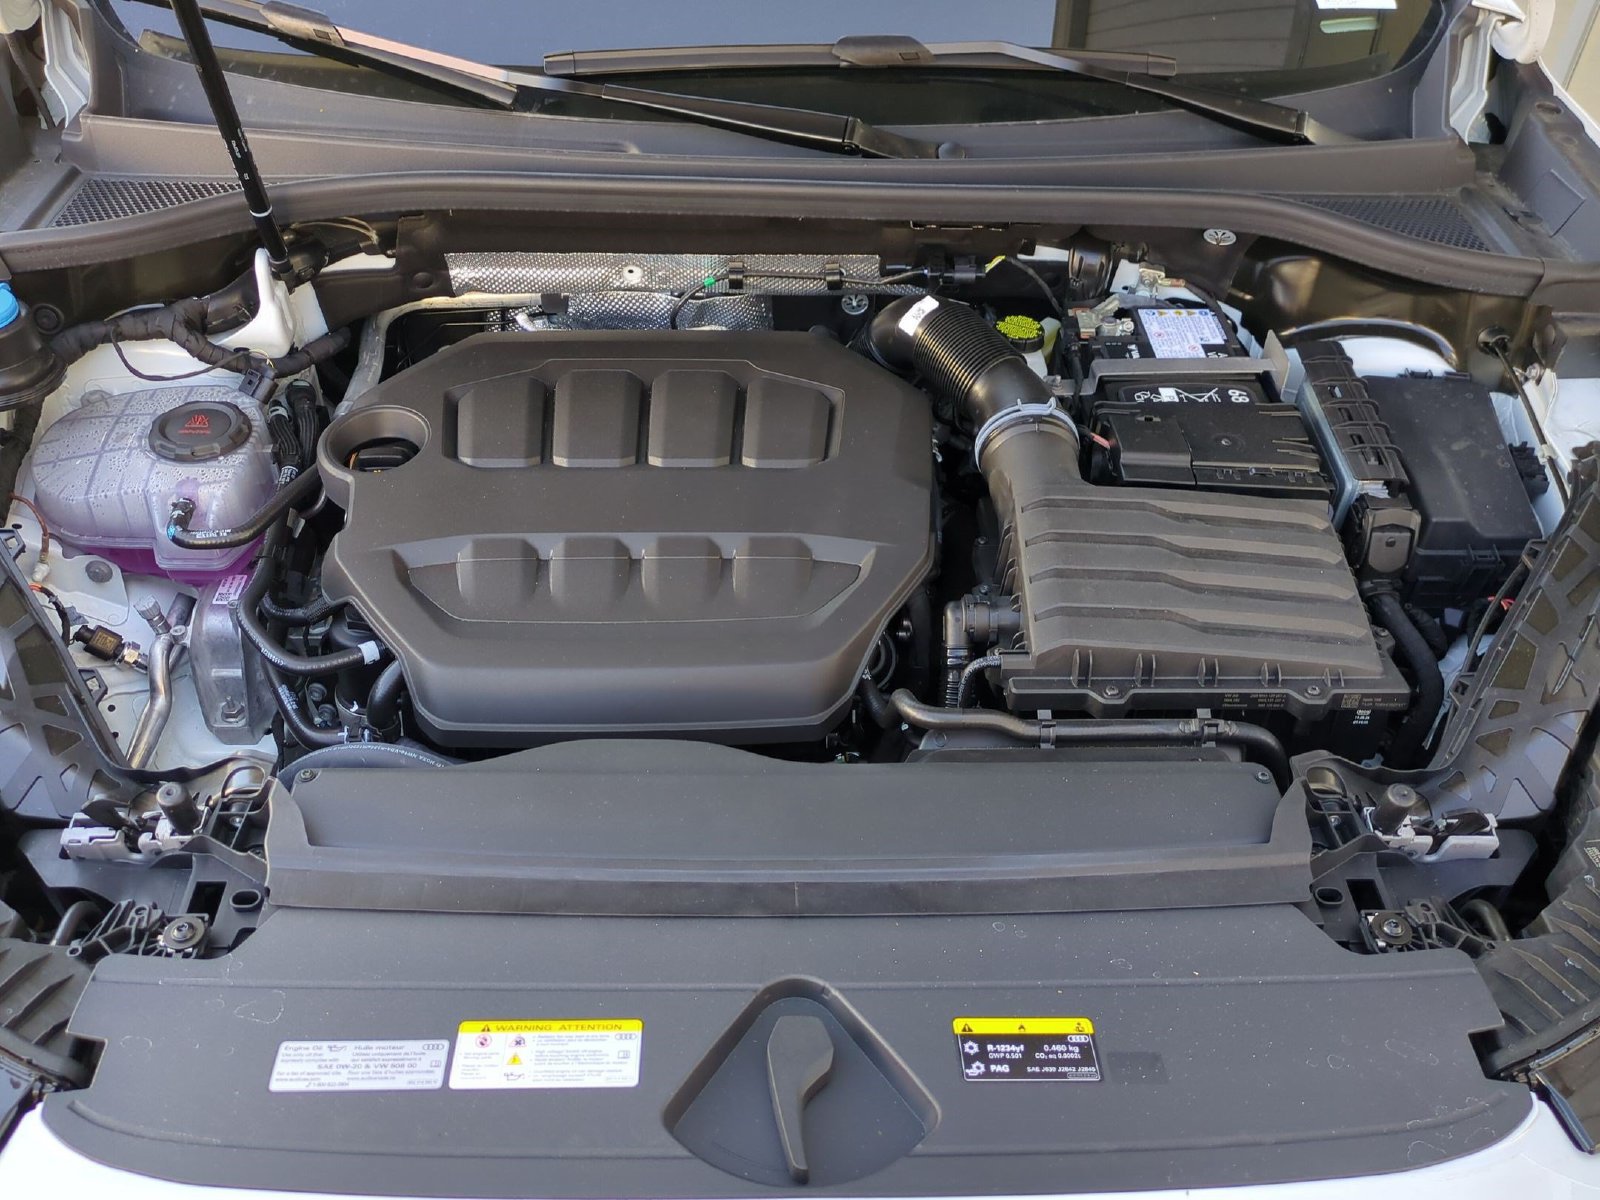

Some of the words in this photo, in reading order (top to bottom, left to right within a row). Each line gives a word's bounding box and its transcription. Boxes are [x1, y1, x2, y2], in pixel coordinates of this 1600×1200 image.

[1228, 389, 1250, 403] 68
[496, 1024, 552, 1032] WARNING
[558, 1022, 623, 1031] ATTENTION
[987, 1044, 1024, 1052] R-1234yf
[1069, 1044, 1079, 1052] kg
